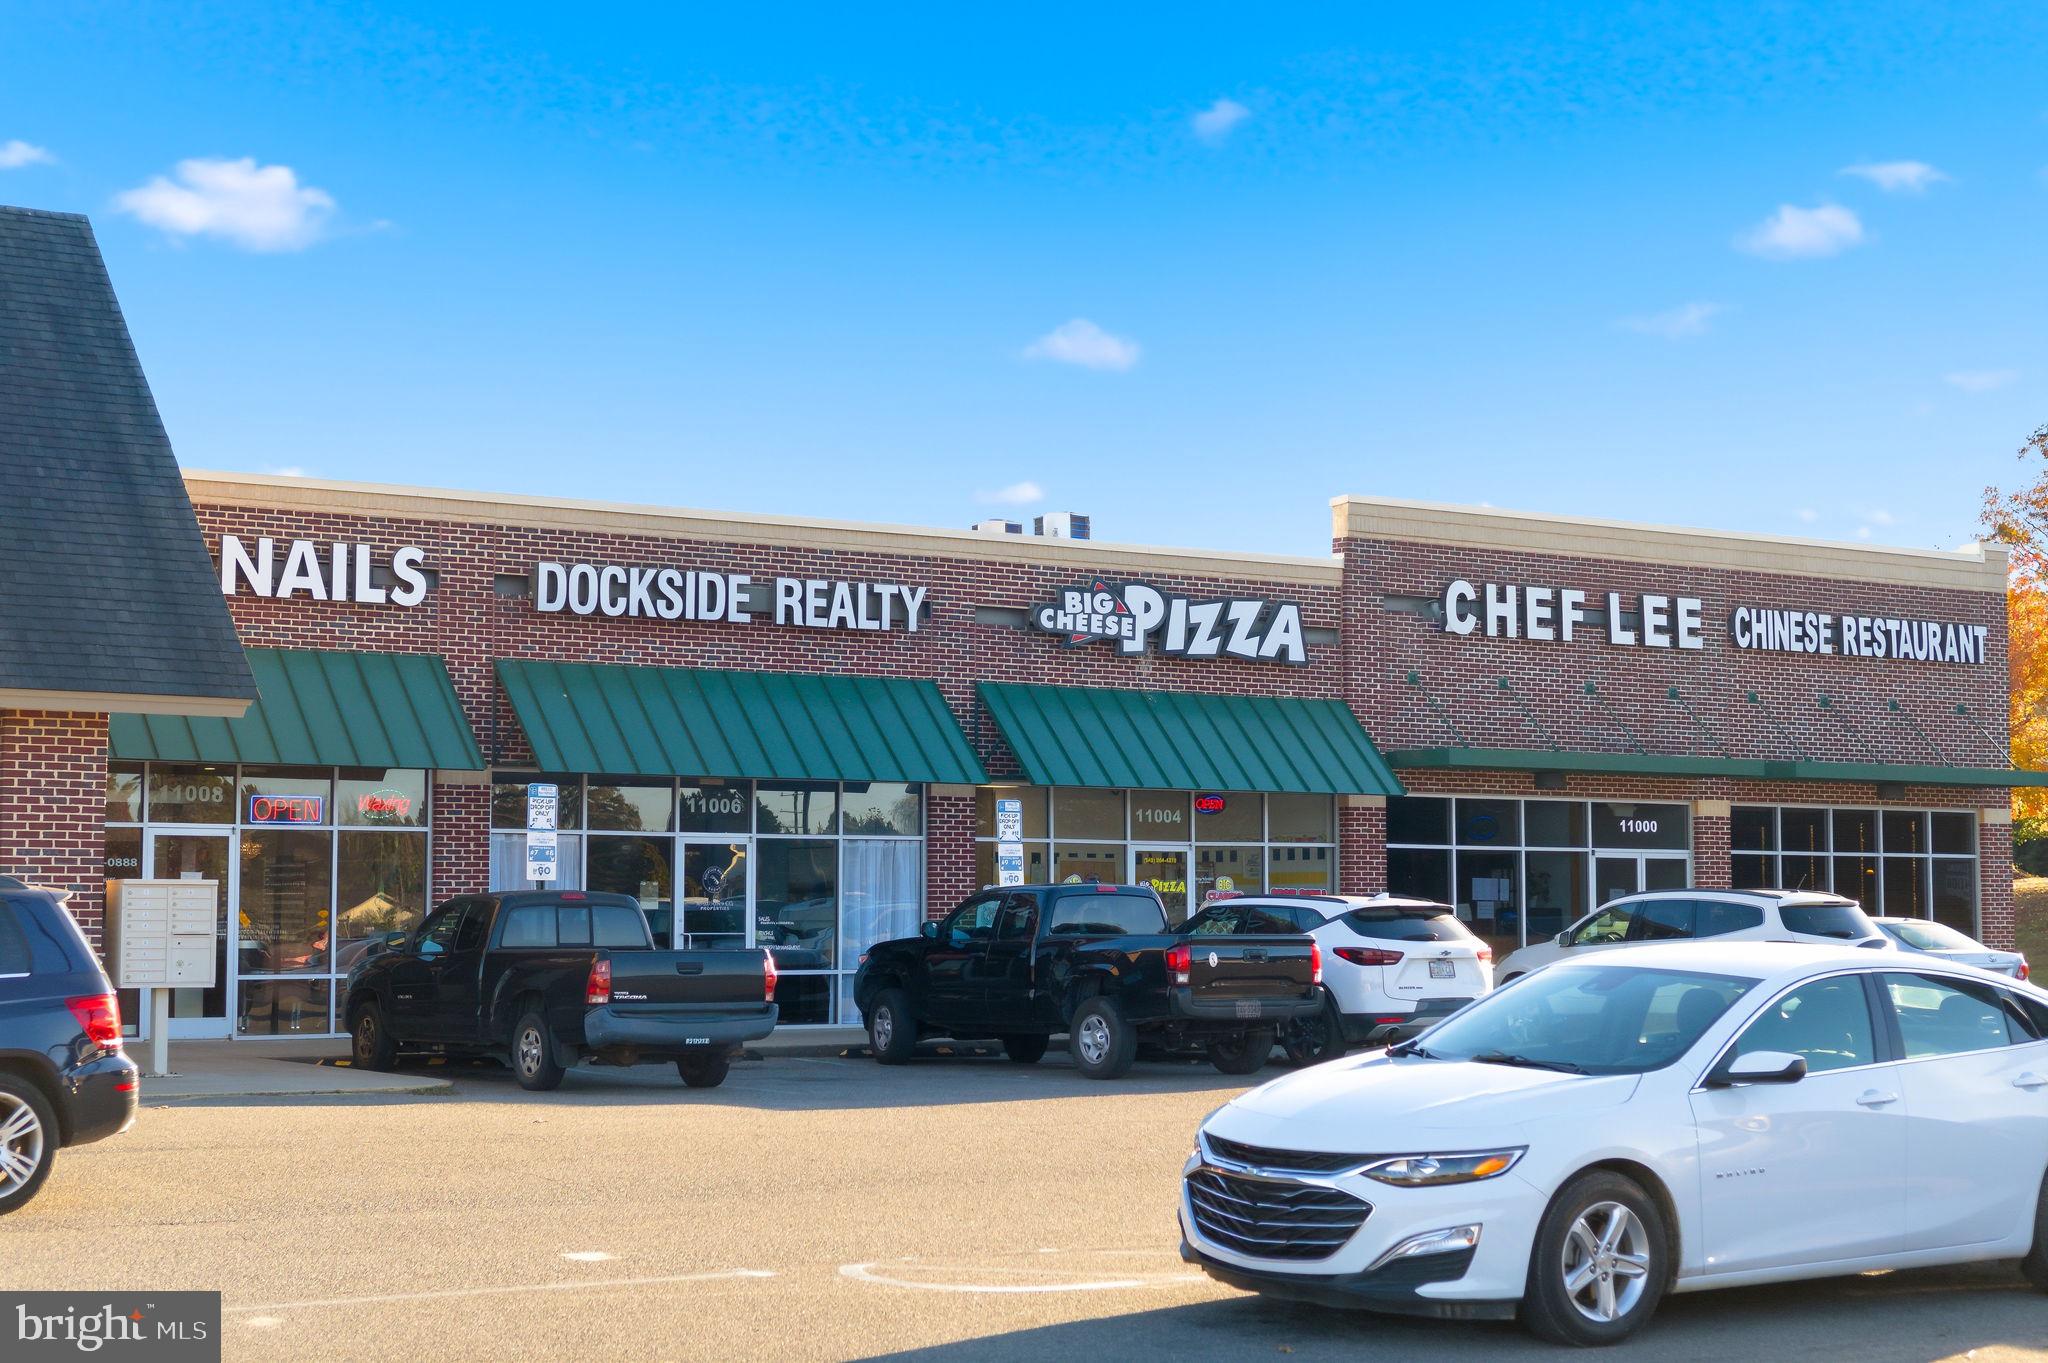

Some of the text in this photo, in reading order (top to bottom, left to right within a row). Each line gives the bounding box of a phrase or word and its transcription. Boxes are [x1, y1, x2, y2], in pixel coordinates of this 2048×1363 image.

[221, 535, 427, 607] NAILS
[537, 562, 927, 632] DOCKSIDE REALTY
[1064, 591, 1114, 614] BIG
[1040, 608, 1133, 637] CHEESE
[1124, 585, 1306, 662] PIZZA
[1445, 580, 1702, 650] CHEF LEE
[1734, 606, 1988, 664] CHINESE RESTAURANT
[160, 785, 224, 803] 11008
[1195, 799, 1223, 810] OPEN
[253, 797, 320, 821] OPEN
[688, 799, 741, 813] 11006
[1136, 808, 1181, 824] 11004
[1619, 819, 1658, 833] 11000
[1150, 879, 1186, 893] PIZZA
[1219, 879, 1232, 891] BIG
